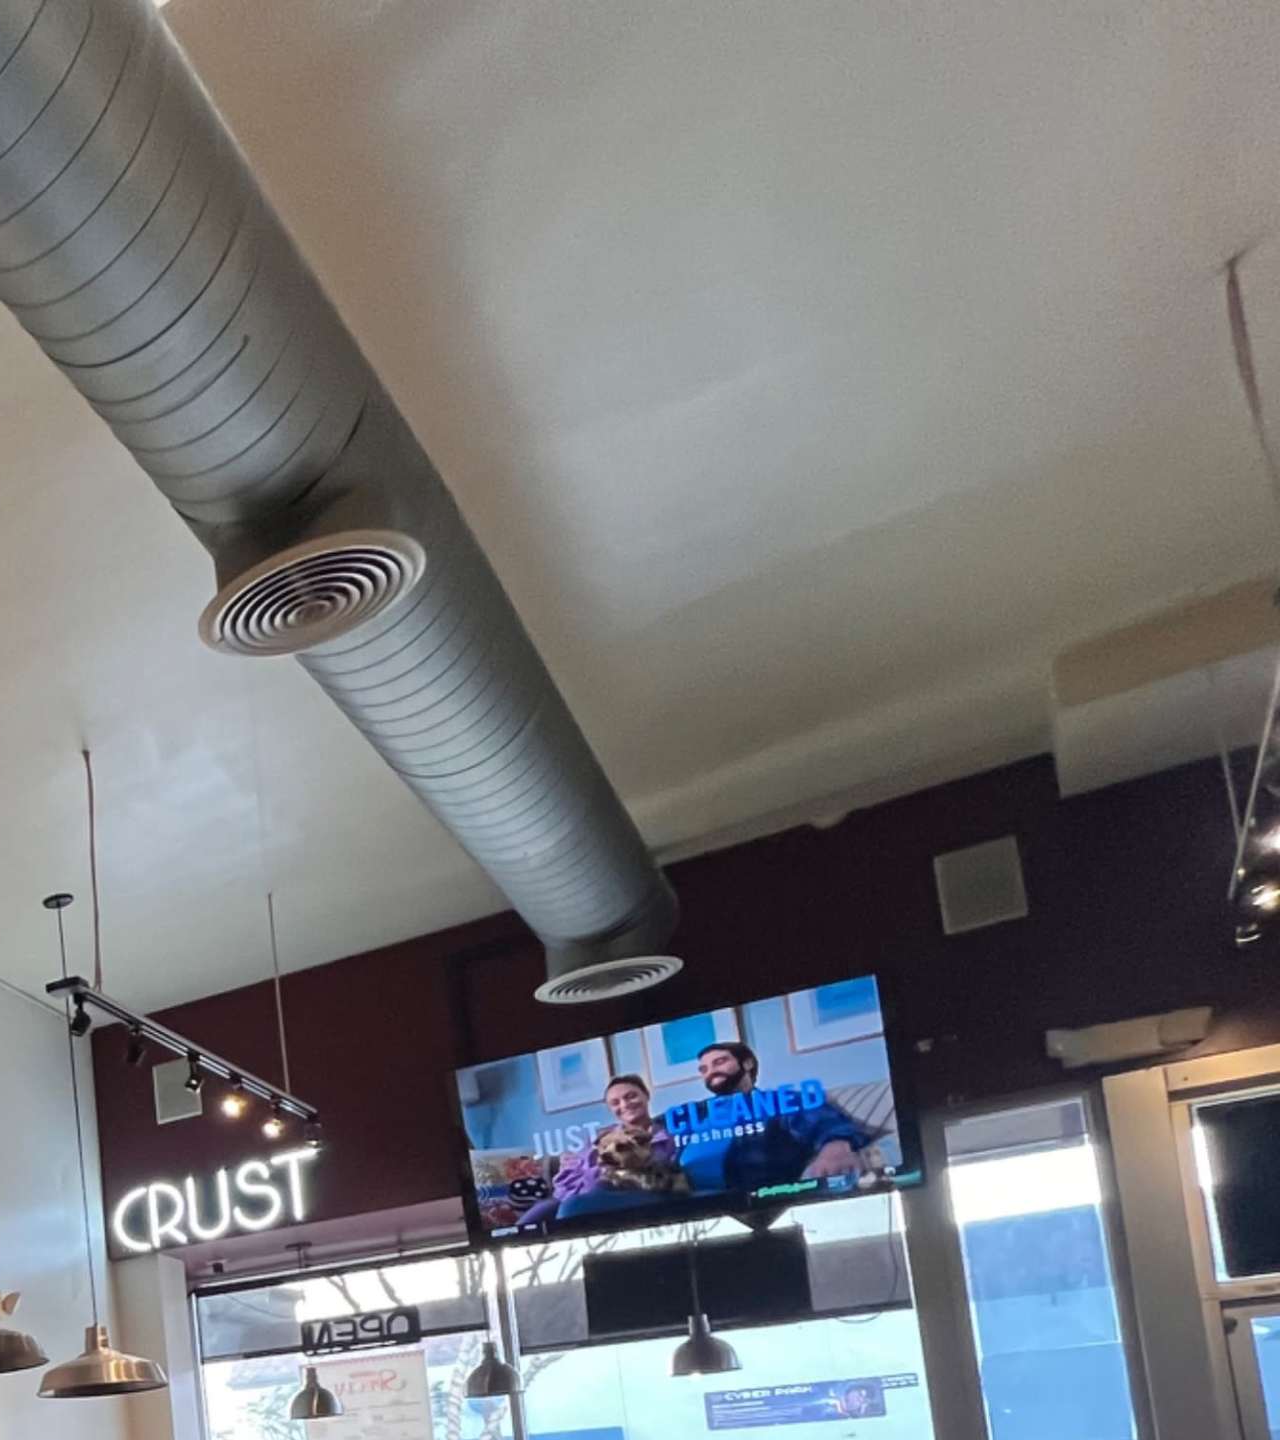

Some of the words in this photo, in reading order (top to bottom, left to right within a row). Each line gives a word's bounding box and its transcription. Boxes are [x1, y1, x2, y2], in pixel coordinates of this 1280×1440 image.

[532, 1120, 602, 1161] JUST
[664, 1078, 827, 1136] CLEANED
[673, 1120, 766, 1148] freshness
[112, 1148, 321, 1252] CRUST
